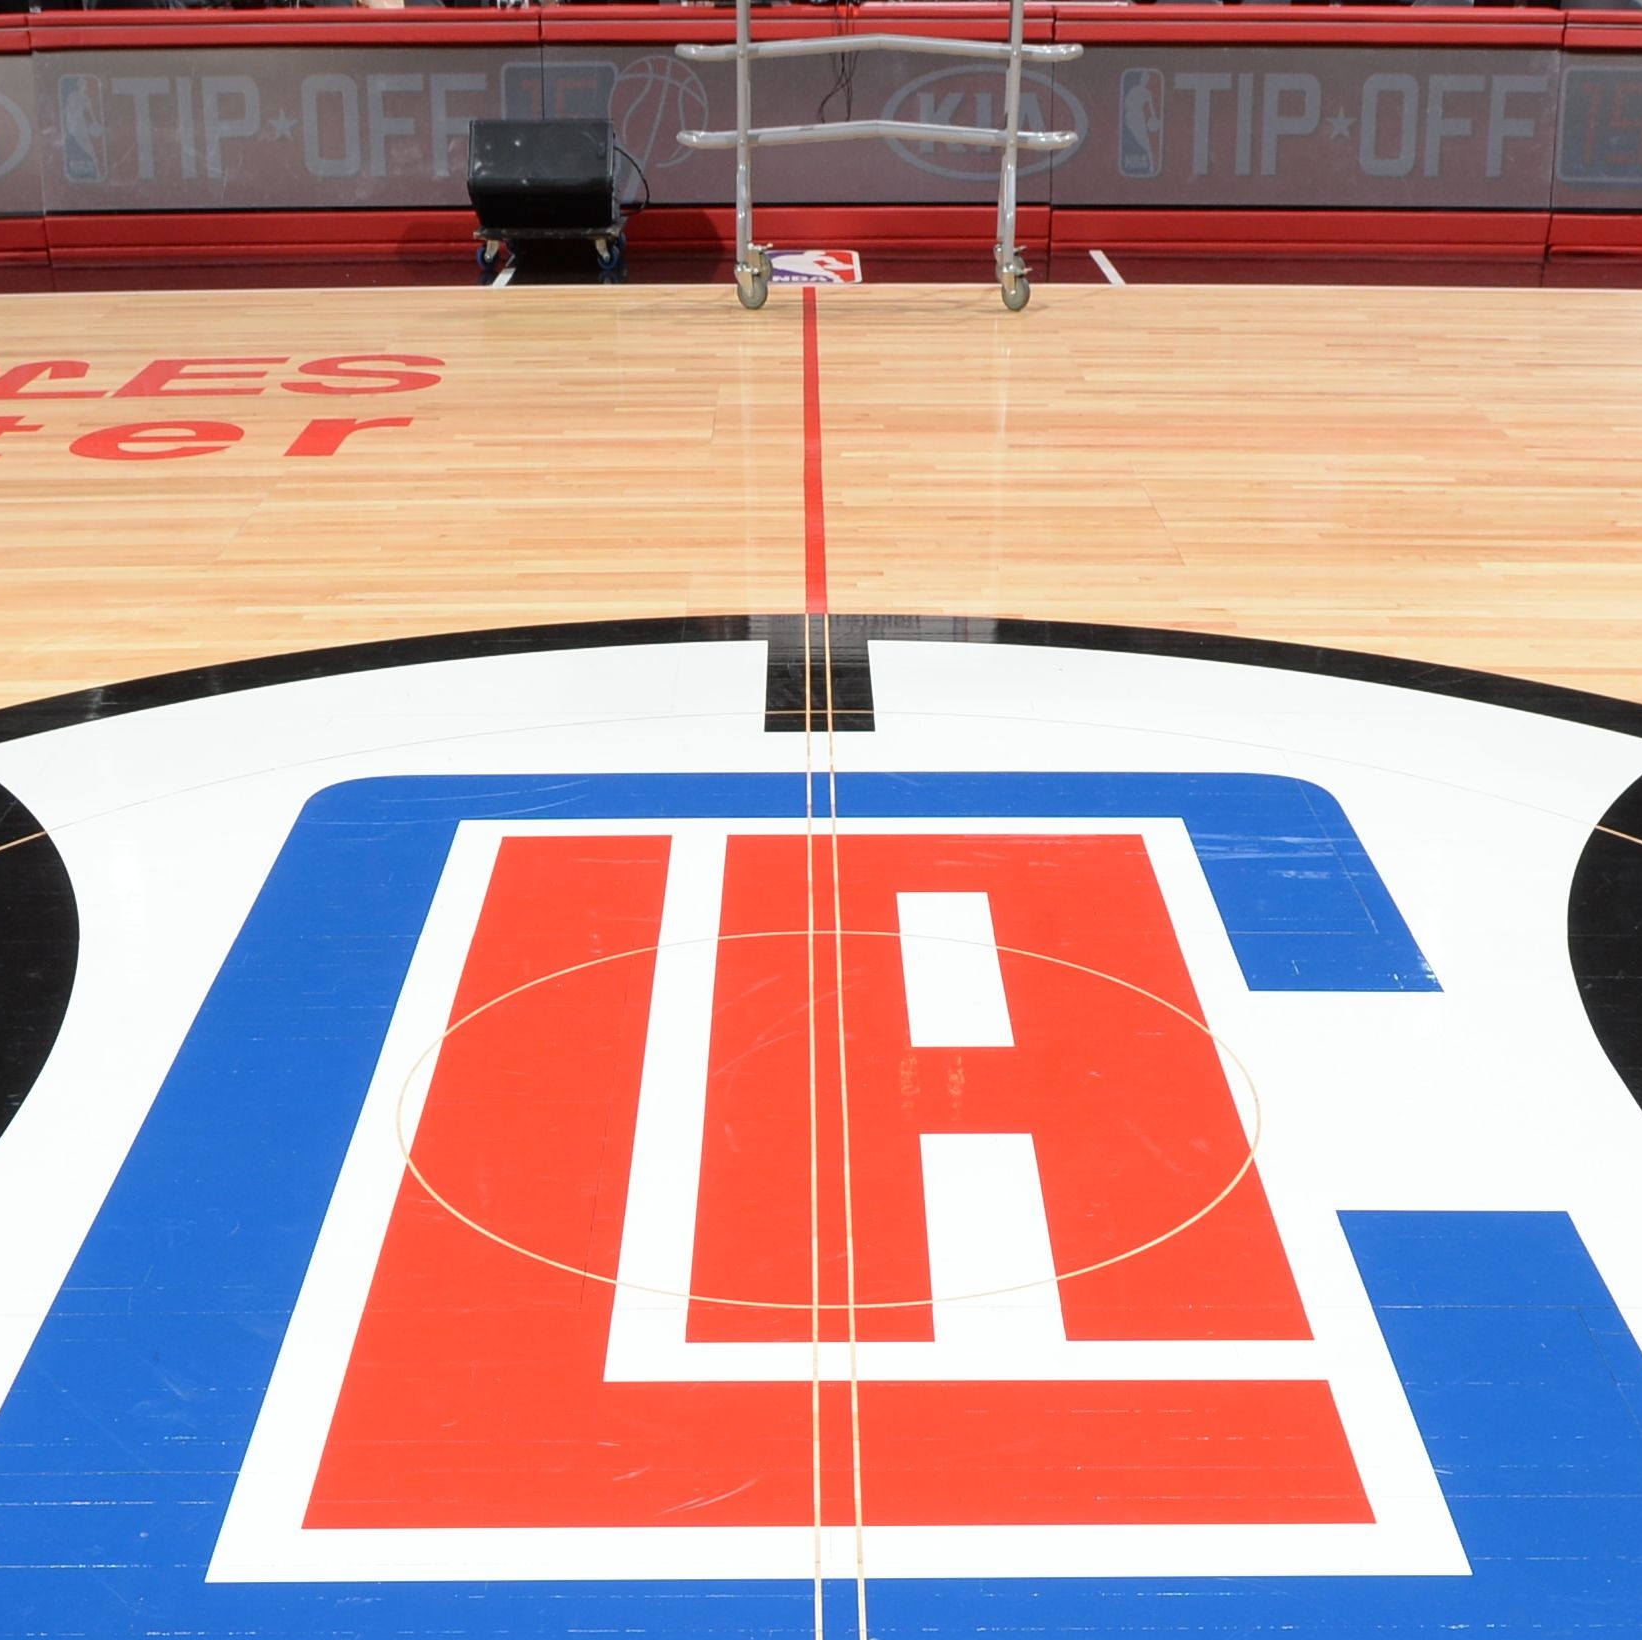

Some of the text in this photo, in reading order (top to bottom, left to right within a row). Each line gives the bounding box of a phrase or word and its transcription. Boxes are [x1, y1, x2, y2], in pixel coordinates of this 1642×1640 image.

[110, 72, 488, 180] TIP OFF
[1173, 71, 1550, 179] TIP OFF
